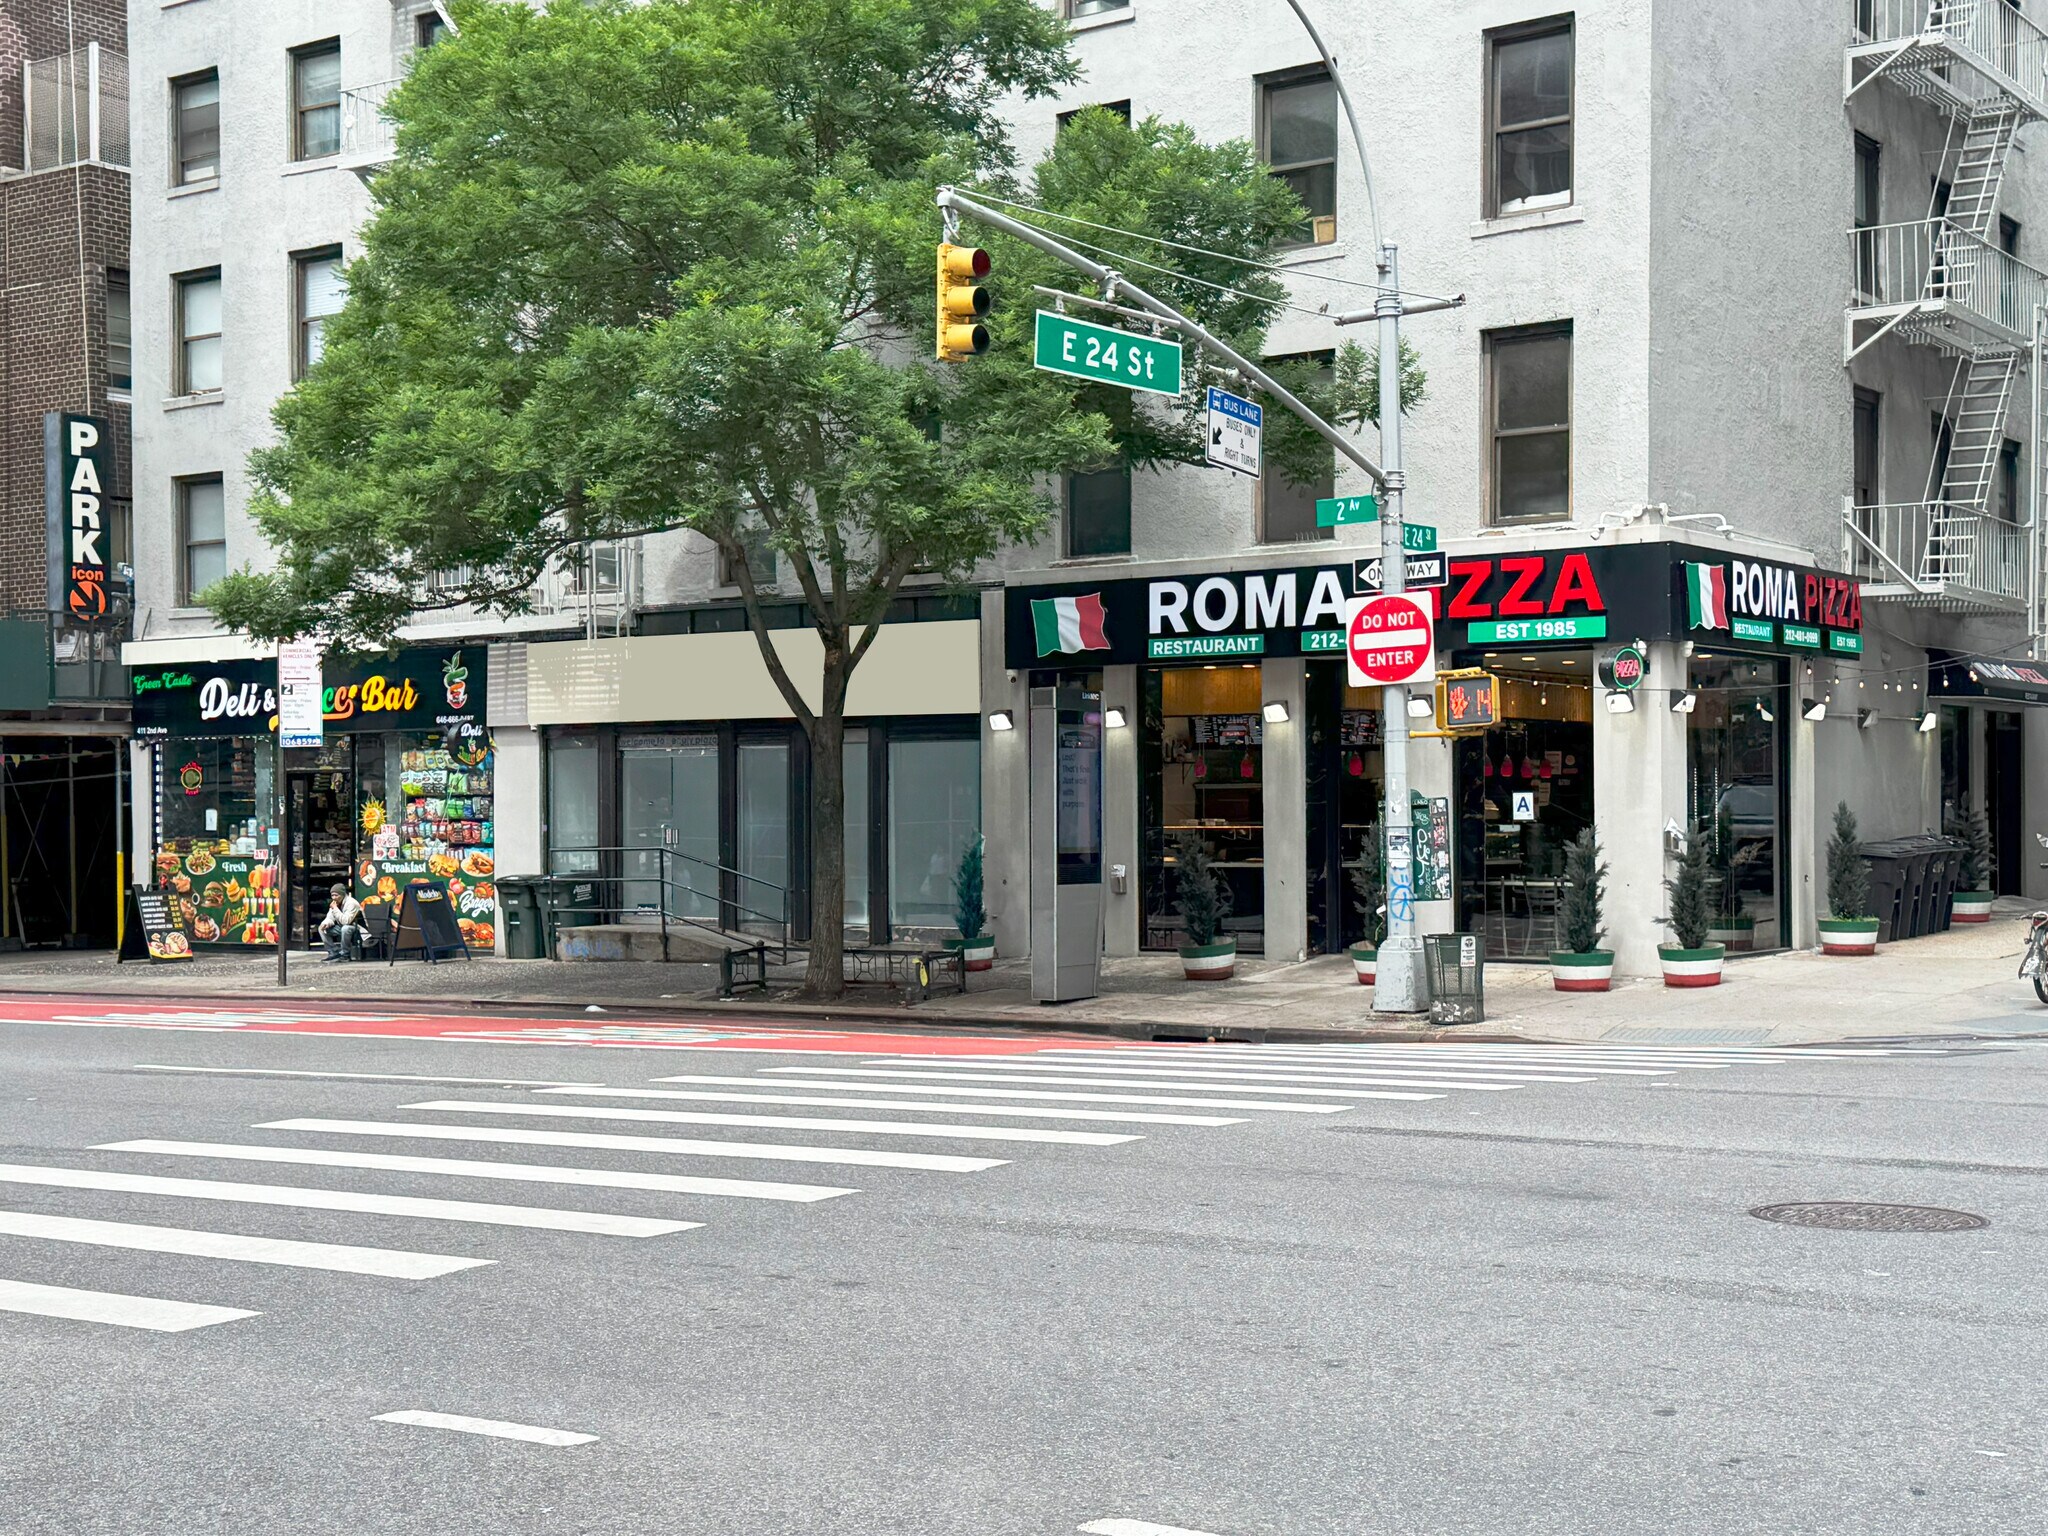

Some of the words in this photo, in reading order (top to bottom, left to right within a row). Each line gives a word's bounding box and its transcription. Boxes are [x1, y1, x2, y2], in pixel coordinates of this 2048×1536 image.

[1063, 330, 1077, 363] E
[1085, 337, 1119, 372] 24
[1127, 346, 1155, 380] St
[1223, 398, 1239, 414] BUS
[1240, 405, 1259, 422] LANE
[1225, 417, 1243, 433] BUSES
[1244, 425, 1256, 438] ONLY
[1240, 438, 1245, 450] &
[1224, 447, 1239, 461] RIGHT
[1241, 453, 1257, 468] TURNS
[70, 421, 103, 565] PARK
[1336, 501, 1346, 521] 2
[1349, 499, 1360, 511] Av
[1404, 526, 1411, 546] E
[1412, 527, 1424, 548] 24
[72, 565, 104, 581] icon
[1405, 562, 1434, 578] WAY
[1149, 569, 1347, 635] ROMA
[1732, 559, 1800, 621] ROMA
[1804, 573, 1863, 629] PIZZA
[1362, 614, 1382, 630] DO
[1387, 611, 1416, 628] NOT
[1153, 637, 1259, 655] RESTAURANT
[1496, 622, 1530, 639] EST
[1535, 620, 1577, 637] 1985
[1734, 622, 1770, 637] RESTAURANT
[1836, 635, 1846, 647] EST
[1367, 650, 1415, 668] ENTER
[1615, 659, 1640, 678] PIZZA
[133, 674, 161, 695] Green
[162, 672, 193, 689] Castle
[283, 684, 291, 695] 2
[199, 677, 262, 721] Deli
[263, 689, 276, 712] &
[361, 675, 419, 712] Bar
[1476, 688, 1492, 715] 14
[136, 727, 147, 735] 411
[147, 726, 157, 735] 2nd
[157, 726, 168, 734] Ave
[460, 723, 483, 737] Deli
[1516, 796, 1530, 813] A
[381, 824, 397, 834] ATM
[255, 850, 269, 860] ATM
[222, 861, 247, 873] Fresh
[382, 861, 427, 873] Breakfast
